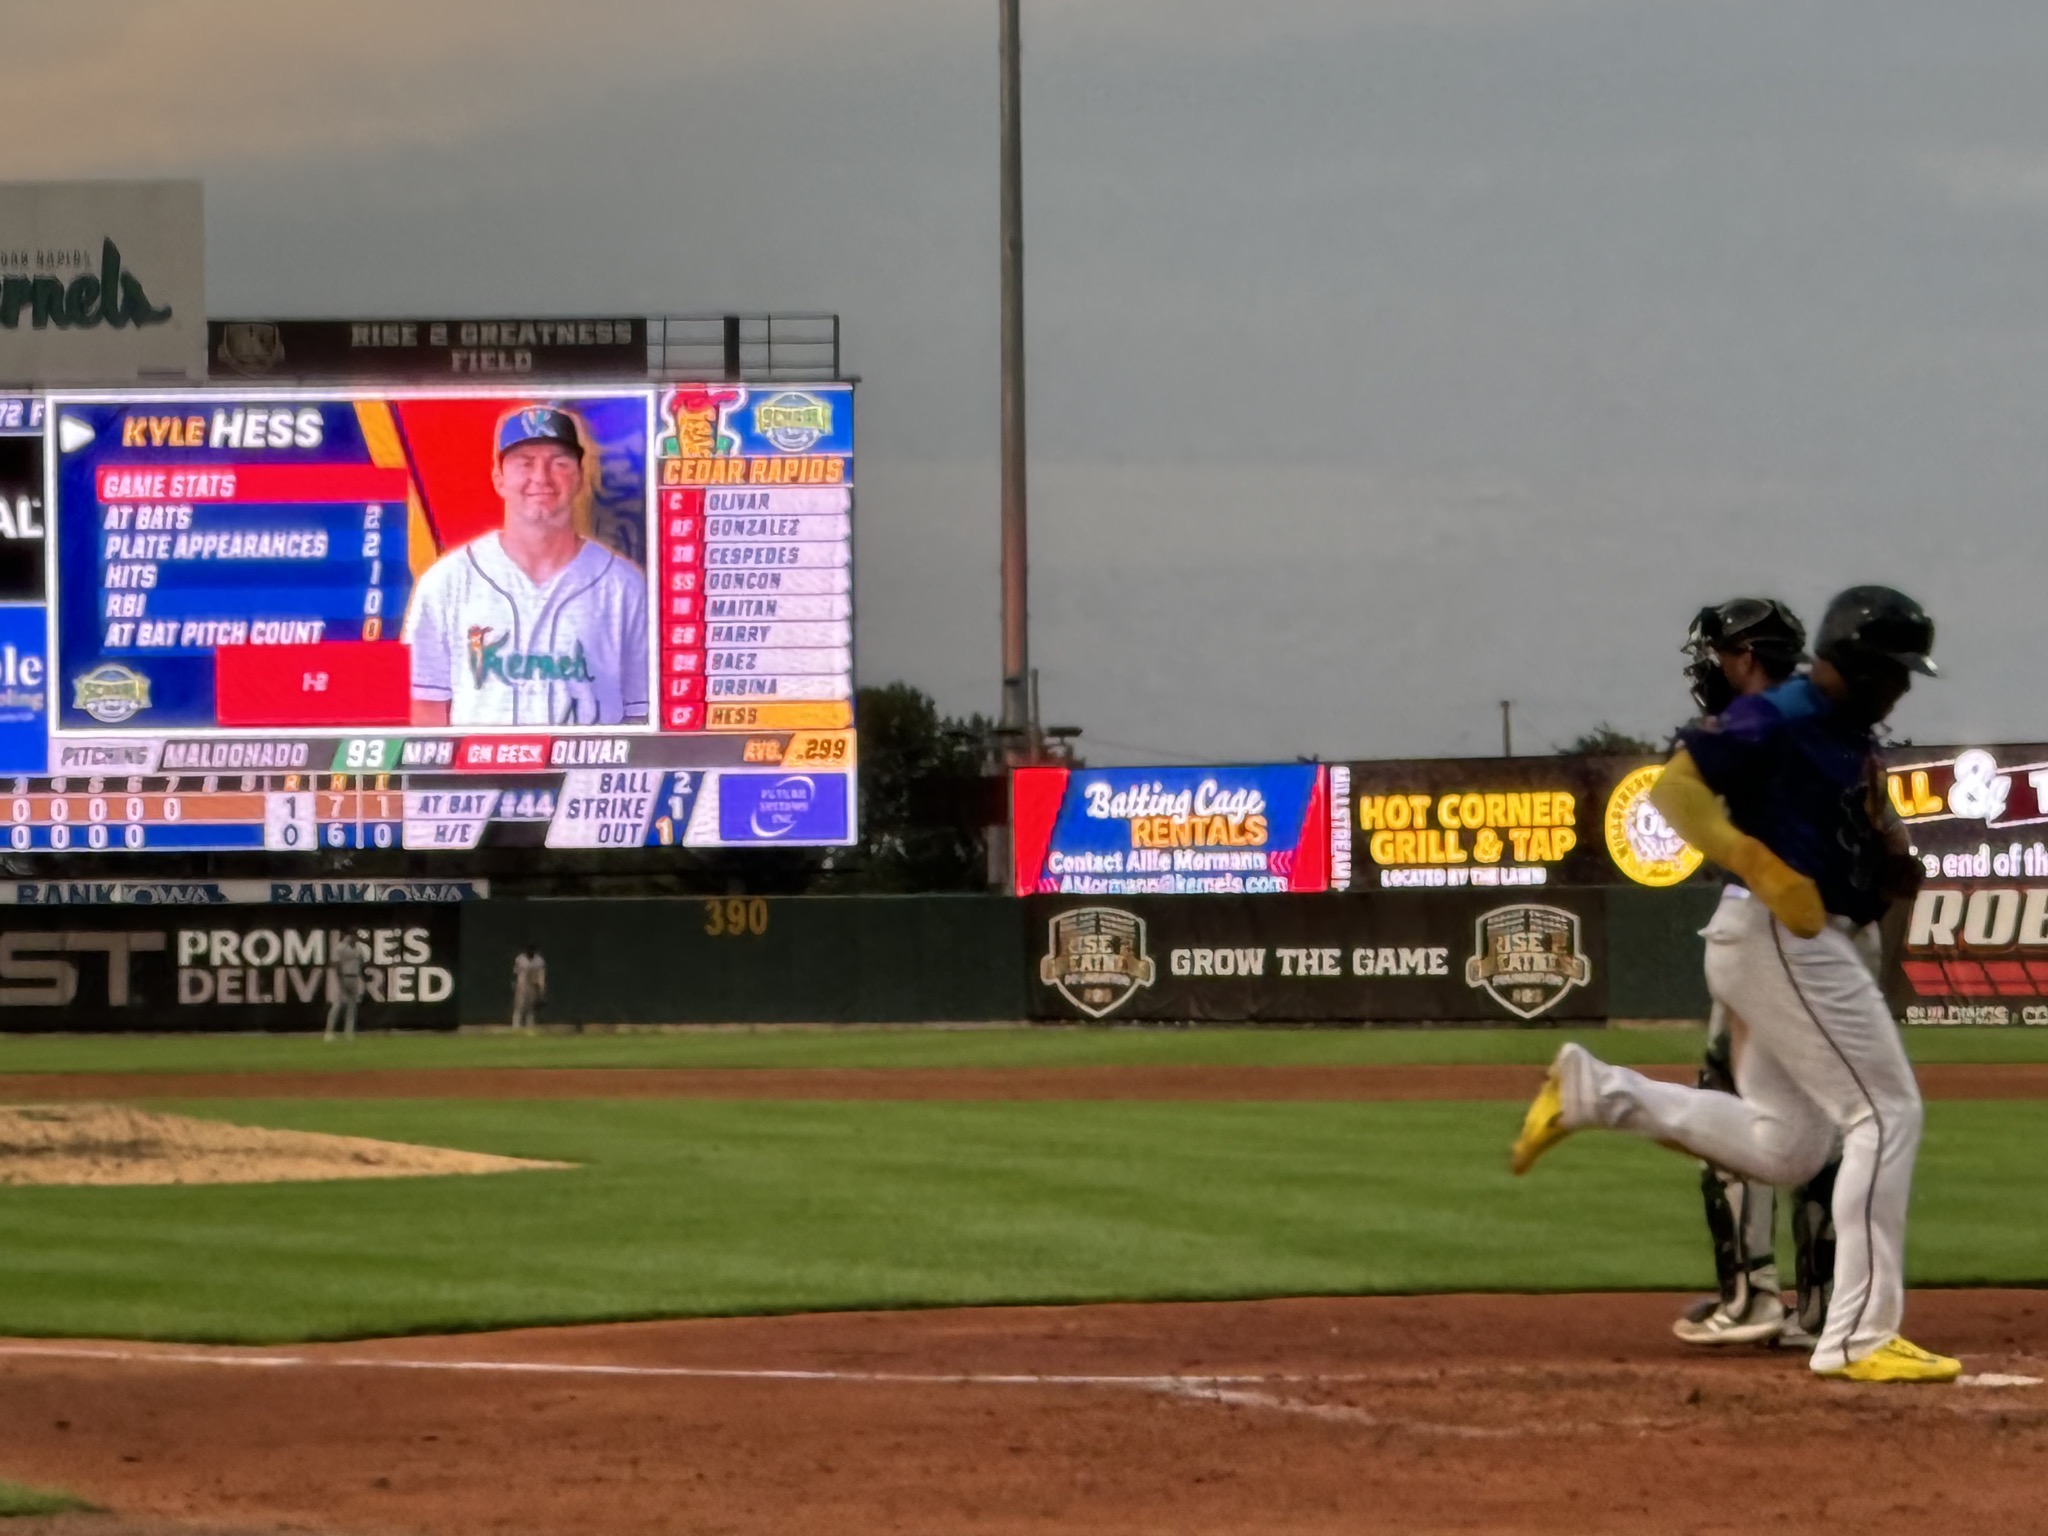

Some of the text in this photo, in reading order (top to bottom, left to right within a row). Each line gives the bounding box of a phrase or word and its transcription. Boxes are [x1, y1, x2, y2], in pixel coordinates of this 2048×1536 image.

[0, 235, 172, 330] rnels
[451, 350, 532, 373] FIELD
[122, 408, 324, 448] KYLE HESS
[664, 457, 845, 485] CEDAR RAPIDS
[103, 474, 236, 498] GAME STATS
[709, 493, 770, 510] OLIVAR
[103, 505, 133, 530] AT
[135, 505, 193, 530] BATS
[709, 519, 800, 536] GONZALEZ
[104, 532, 381, 559] PLATE APPEARANCES 2
[708, 547, 800, 564] CESPEDES
[105, 563, 158, 588] HITS
[106, 588, 382, 618] RBI 0
[710, 600, 778, 616] MAITAN
[104, 622, 135, 647] AT
[136, 621, 180, 647] BAT
[180, 621, 248, 646] PITCH
[250, 620, 326, 645] COUNT
[711, 626, 771, 642] HARRY
[0, 645, 43, 686] le
[711, 653, 758, 670] BAEZ
[711, 707, 758, 725] HESS
[162, 740, 454, 768] MALDONADO 93 MPH
[551, 739, 629, 764] OLIVAR
[796, 738, 847, 760] .299
[600, 771, 693, 794] BALL 2
[1948, 749, 2012, 829] &
[13, 795, 389, 822] 0 0 0 0 0 1 7 1
[417, 796, 442, 814] AT
[450, 795, 486, 814] BAT
[567, 796, 684, 820] STRIKE 1
[1085, 779, 1266, 824] Batting Cage
[1360, 792, 1575, 830] HOT CORNER
[11, 823, 392, 849] 0 0 0 0 0 6 0
[598, 816, 674, 845] OUT 1
[1131, 815, 1269, 849] RENTALS
[1370, 827, 1577, 864] GRILL & TAP
[1049, 852, 1122, 874] Contact
[1943, 844, 1991, 878] end
[1993, 843, 2023, 878] of
[17, 884, 116, 904] BANK
[271, 884, 370, 904] BANK
[704, 898, 768, 936] 390
[1170, 947, 1449, 976] GROW THE GAME
